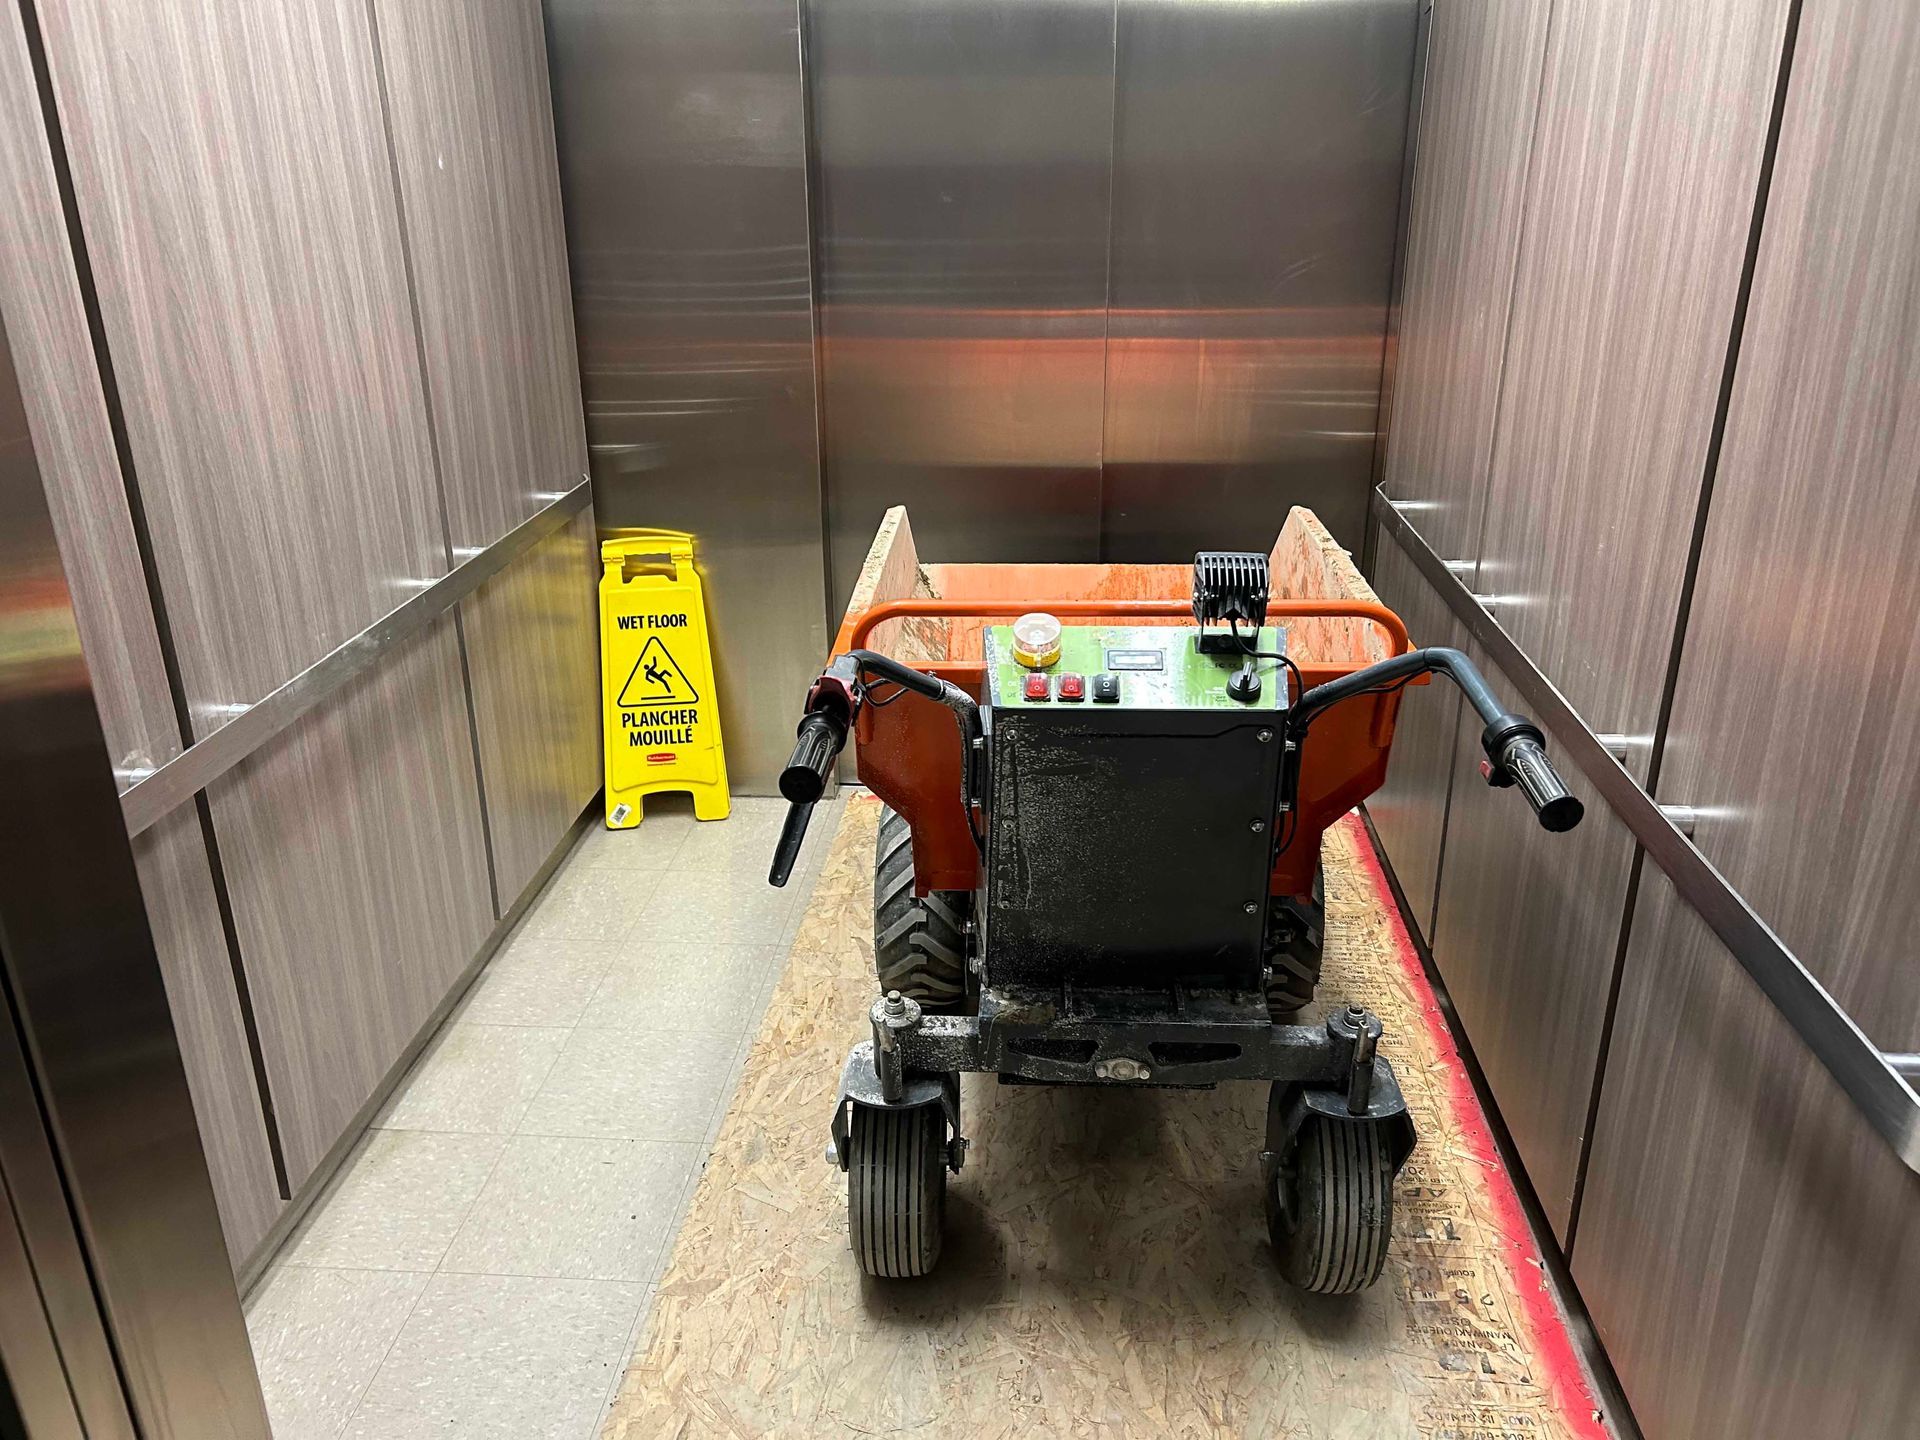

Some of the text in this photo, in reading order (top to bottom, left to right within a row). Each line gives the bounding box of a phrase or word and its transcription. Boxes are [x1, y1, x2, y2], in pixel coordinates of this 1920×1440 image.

[617, 613, 688, 630] WET FLOOR
[621, 708, 699, 728] PLANCHER
[629, 725, 694, 747] MOUILLÉ
